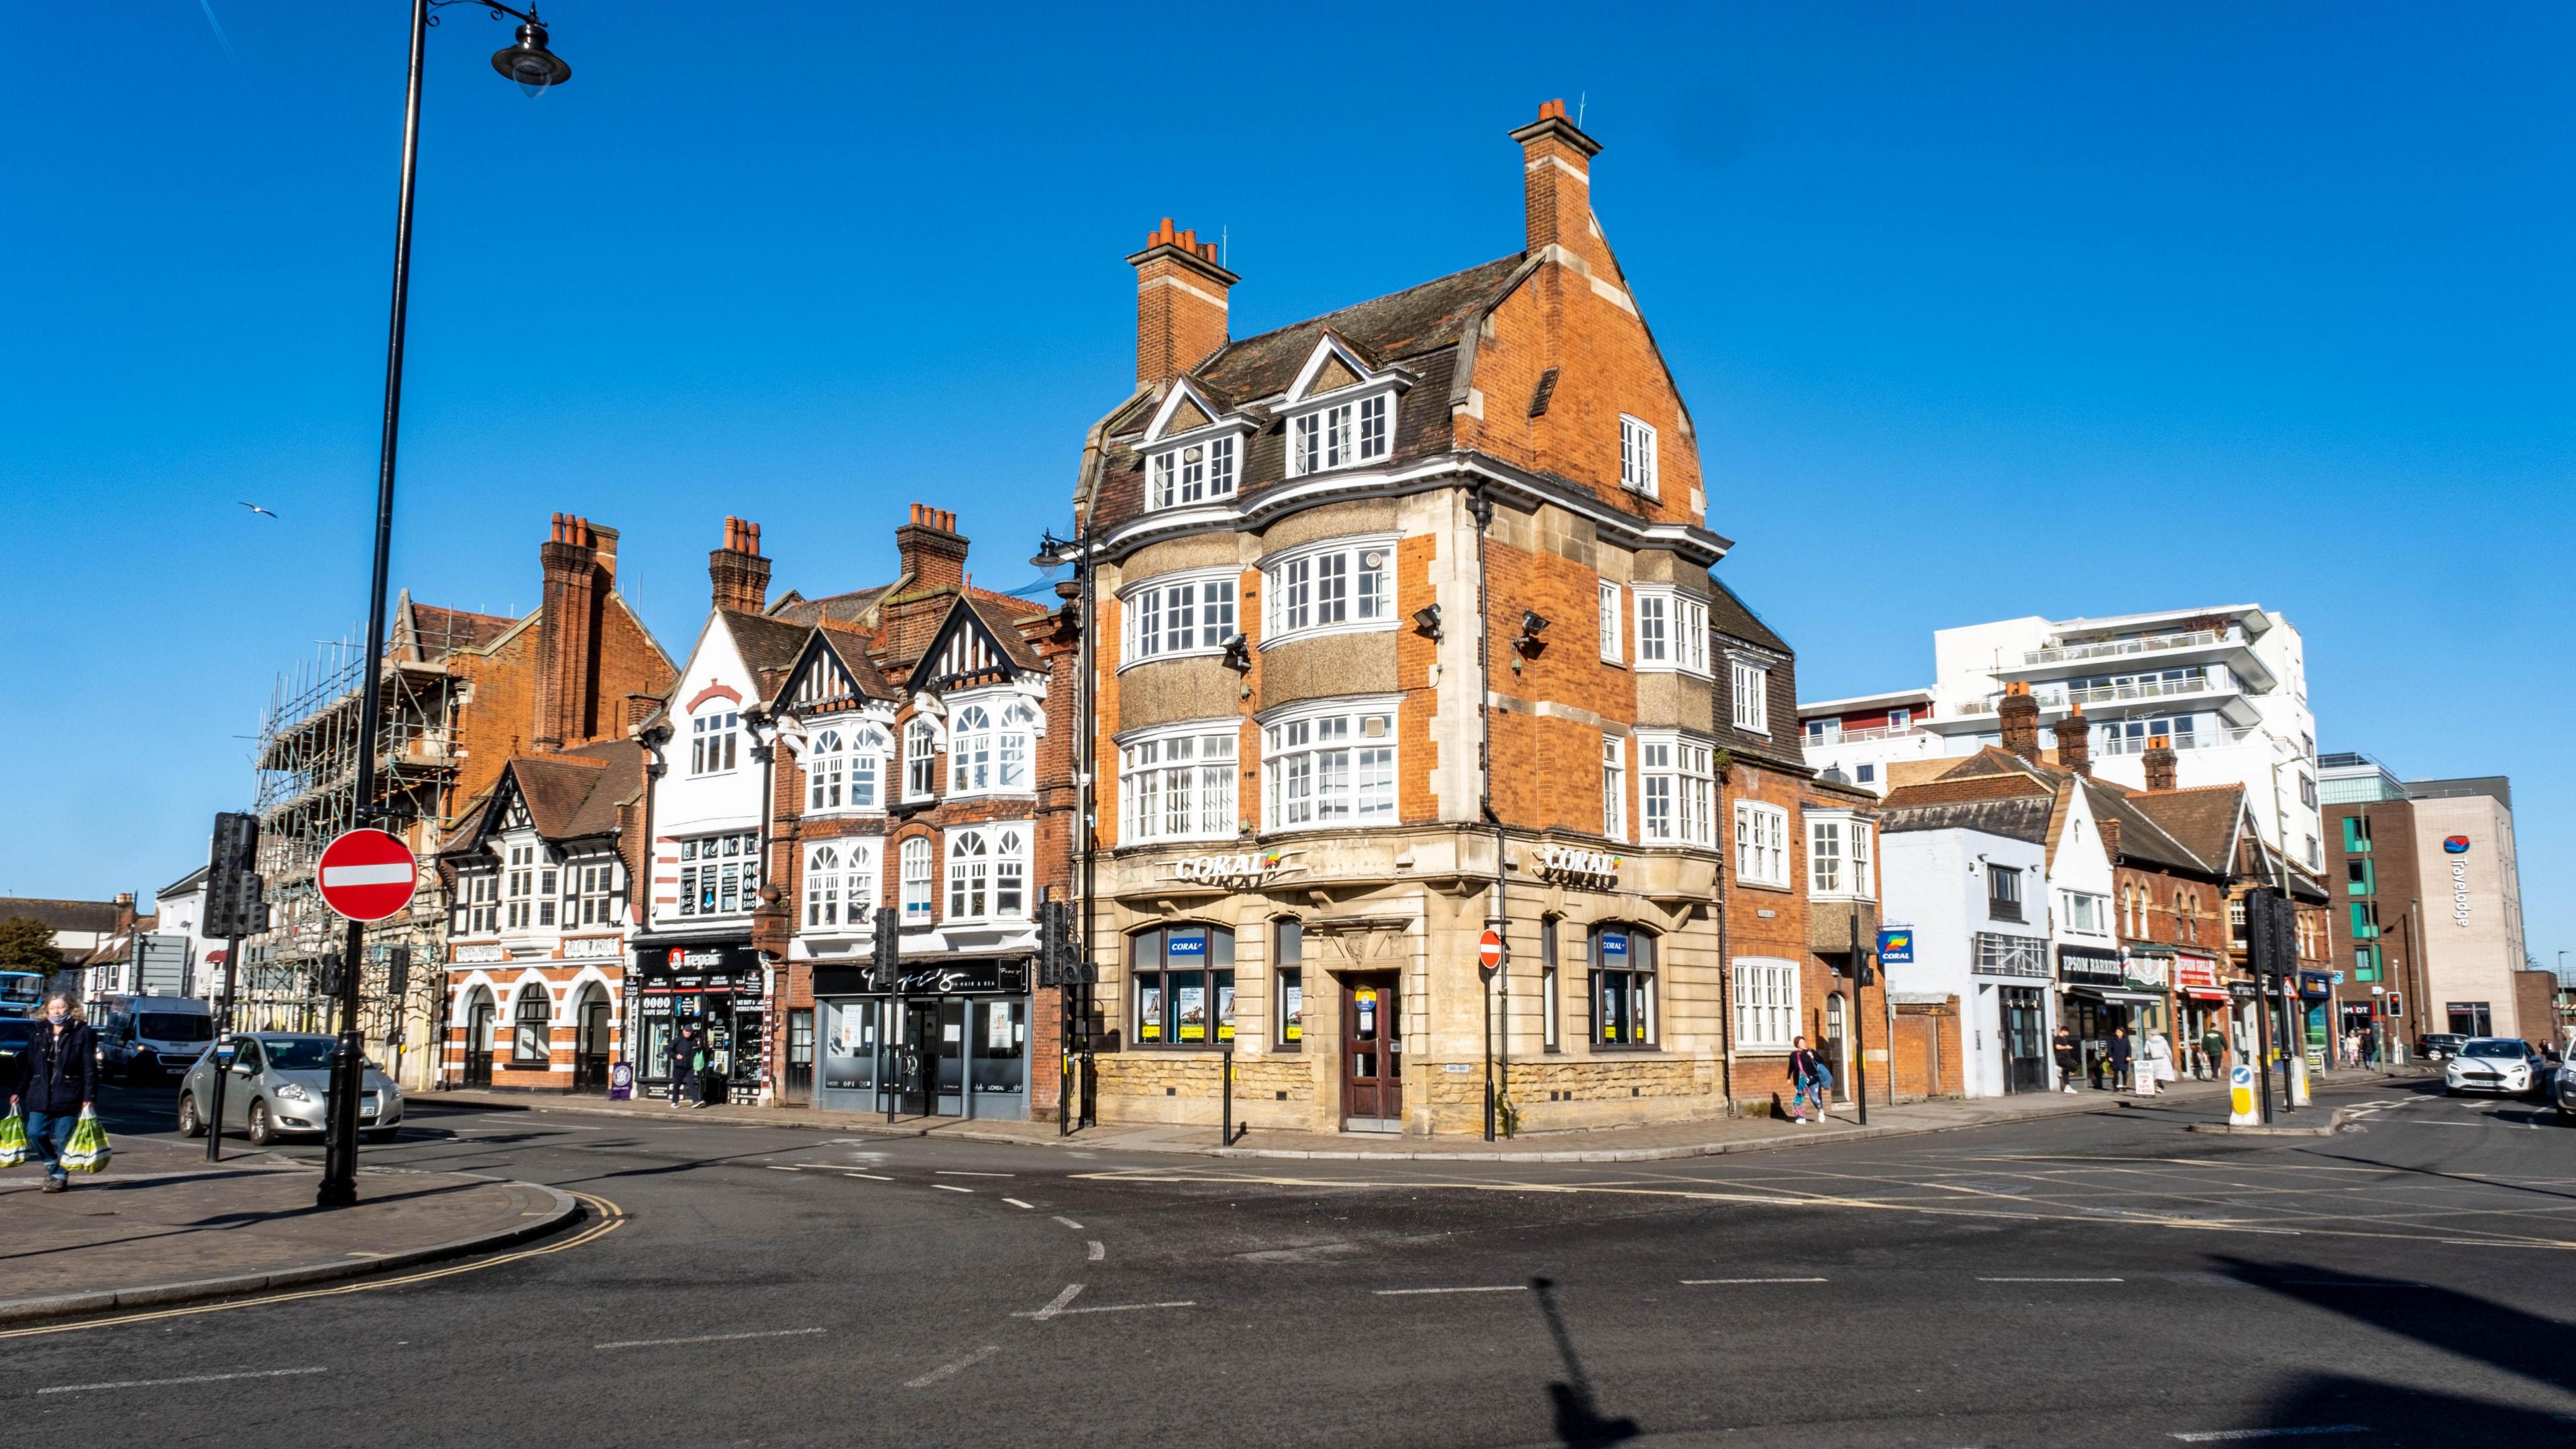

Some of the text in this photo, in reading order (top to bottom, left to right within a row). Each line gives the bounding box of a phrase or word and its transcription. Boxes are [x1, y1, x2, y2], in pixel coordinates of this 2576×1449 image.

[1175, 853, 1264, 879] CORAL
[1546, 848, 1613, 875] CORAL
[2451, 856, 2471, 927] Travelodge
[1171, 943, 1198, 951] CORAL
[1603, 942, 1622, 950] CORAL
[2063, 956, 2121, 975] EPSOM BARBERS
